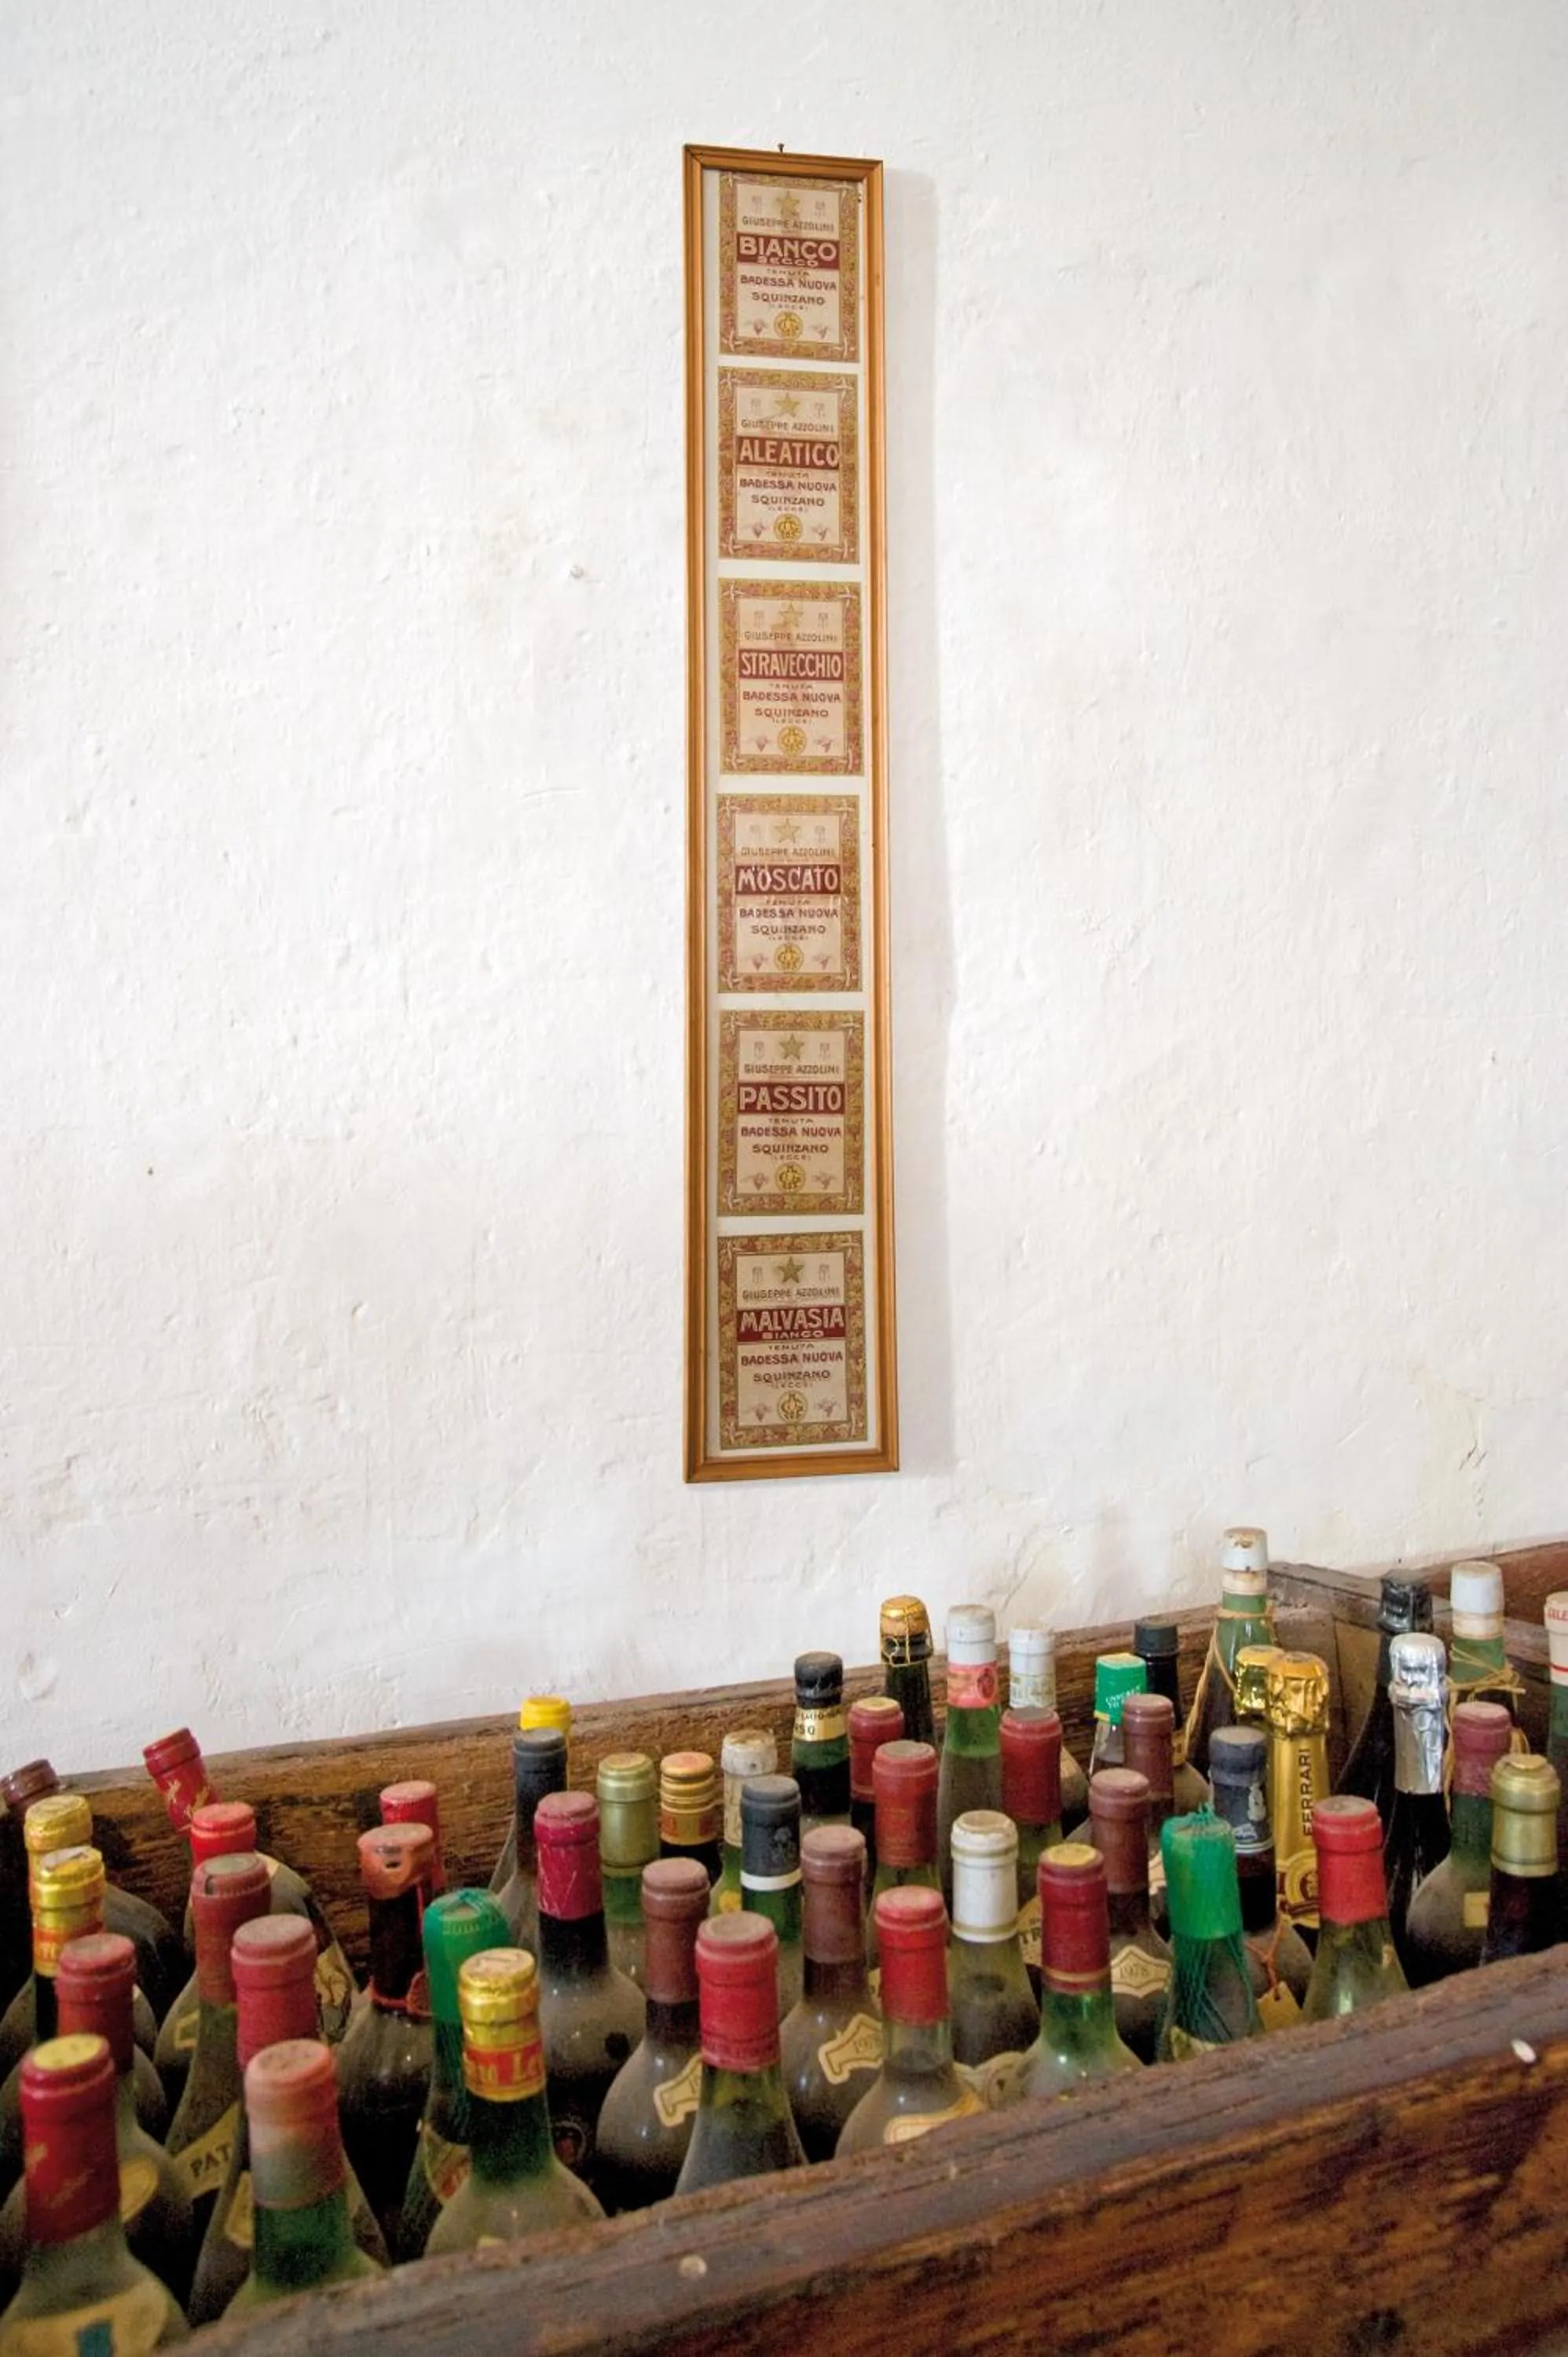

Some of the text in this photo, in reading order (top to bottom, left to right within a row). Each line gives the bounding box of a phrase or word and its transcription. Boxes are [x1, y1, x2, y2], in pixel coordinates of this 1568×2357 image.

[742, 216, 787, 227] GIUSEPPE
[739, 236, 837, 261] BIANCO
[757, 255, 819, 268] SECCO
[741, 275, 837, 291] BADESSA NUOVA
[752, 292, 826, 306] SQUINZANO
[741, 419, 788, 431] GIUSEPPE
[739, 439, 840, 467] ALEATICO
[739, 478, 837, 492] BADESSA NUOVA
[751, 494, 825, 507] SQUINZANO
[744, 631, 791, 641] GIUSEPPE
[741, 651, 842, 677] STRAVECCHIO
[742, 691, 841, 702] BADESSA NUOVA
[754, 708, 830, 718] SQUINZANO
[741, 847, 788, 856] GIUSEPPE
[738, 867, 839, 893] MOSCATO
[739, 907, 838, 918] BADESSA NUOVA
[751, 925, 826, 935] SQUINZANO
[744, 1064, 793, 1074] GIUSEPPE
[739, 1085, 841, 1111] PASSITO
[741, 1126, 841, 1137] BADESSA NUOVA
[753, 1143, 830, 1154] SQUINZANO
[742, 1288, 792, 1300] GIUSEPPE
[740, 1307, 844, 1332] MALVASIA
[761, 1330, 824, 1340] BIANCO
[741, 1351, 843, 1366] BADESSA NUOVA
[753, 1369, 831, 1384] SQUINZANO
[1299, 1748, 1313, 1836] FERRARI
